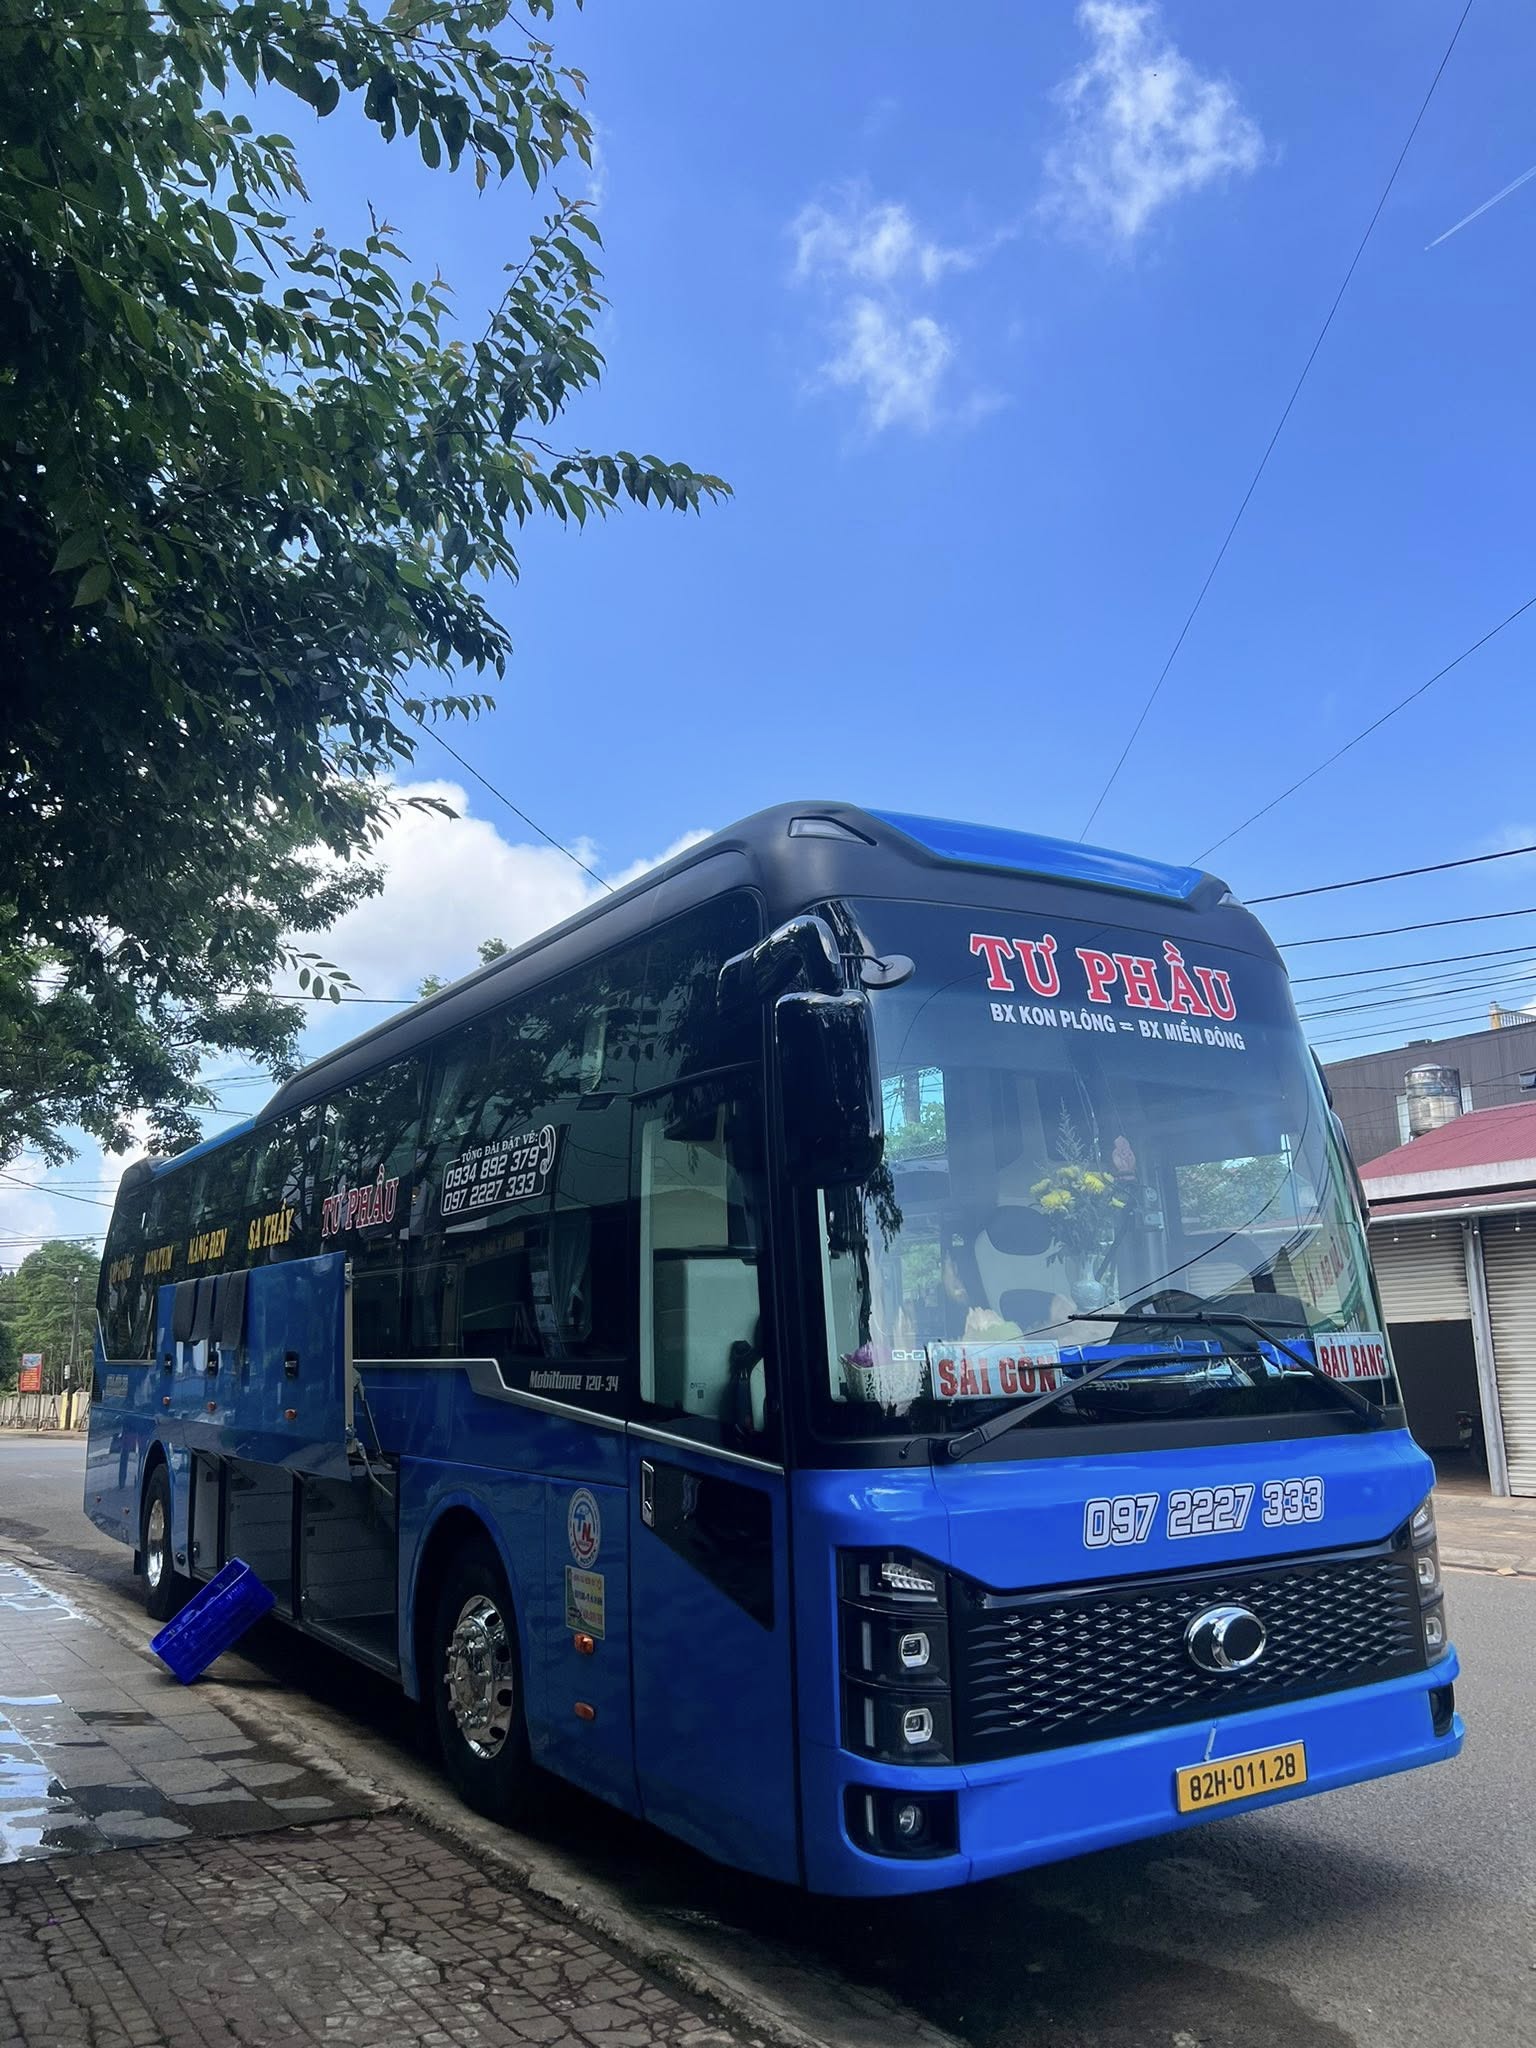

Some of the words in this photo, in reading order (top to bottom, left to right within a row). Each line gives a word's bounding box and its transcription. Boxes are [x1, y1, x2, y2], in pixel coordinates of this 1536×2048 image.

[969, 933, 1060, 997] TƯ
[1075, 940, 1236, 1021] PHẦU
[989, 1003, 1017, 1023] BX
[1019, 1006, 1057, 1027] KON
[1060, 1008, 1117, 1033] PLÔNG
[1138, 1020, 1162, 1039] BX
[1163, 1018, 1203, 1044] MIỀN
[1204, 1026, 1246, 1050] ĐÔNG
[445, 1162, 478, 1189] 0934
[480, 1154, 508, 1180] 892
[510, 1146, 540, 1172] 379
[461, 1146, 483, 1163] TỔNG
[484, 1142, 500, 1156] ĐÀI
[501, 1136, 520, 1152] ĐẶT
[443, 1188, 468, 1212] 097
[469, 1179, 503, 1206] 2227
[506, 1171, 536, 1197] 333
[248, 1217, 261, 1251] SA
[938, 1347, 991, 1397] SÀI
[1350, 1337, 1387, 1377] BÀNG
[1084, 1493, 1159, 1549] 097
[1167, 1482, 1255, 1540] 2227
[1262, 1476, 1325, 1528] 333
[1189, 1753, 1296, 1801] 82H-011.28
